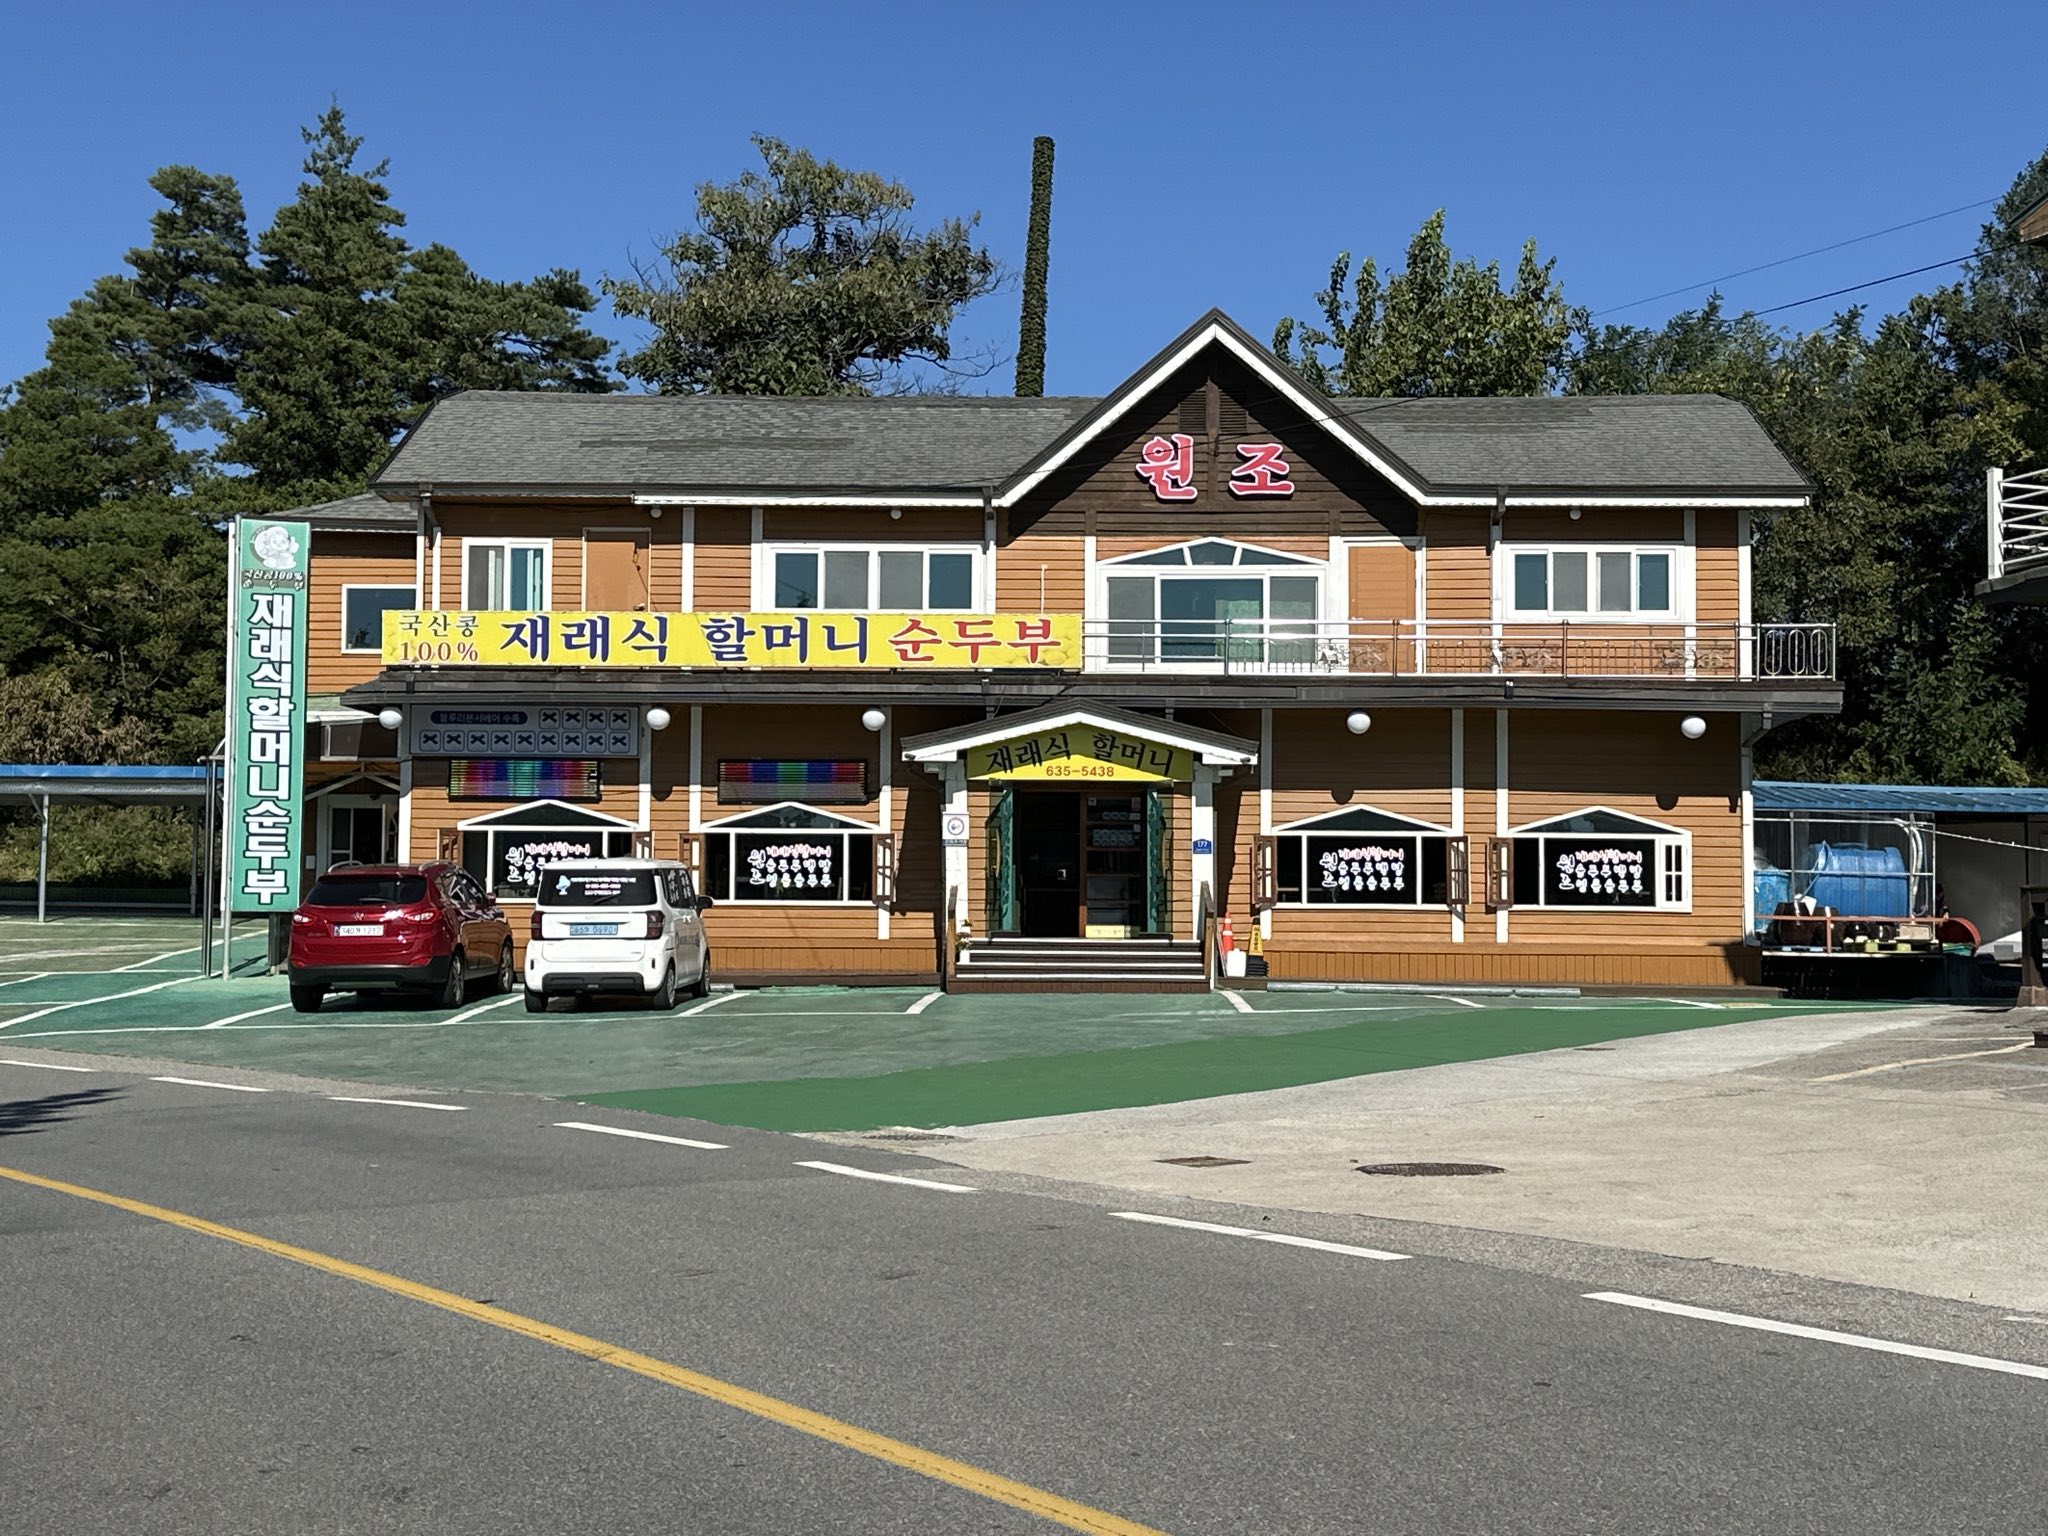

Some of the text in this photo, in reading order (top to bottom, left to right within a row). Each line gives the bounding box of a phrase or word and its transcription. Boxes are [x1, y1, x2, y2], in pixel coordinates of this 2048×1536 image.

[1135, 433, 1295, 500] 원조
[399, 614, 479, 638] 국산콩
[499, 614, 1062, 665] 재래식 할머니 순두부
[400, 641, 478, 662] 100%
[242, 593, 296, 906] 재래식할머니순두부
[986, 732, 1175, 777] 재래식 할머니
[1045, 765, 1115, 777] 635-5438
